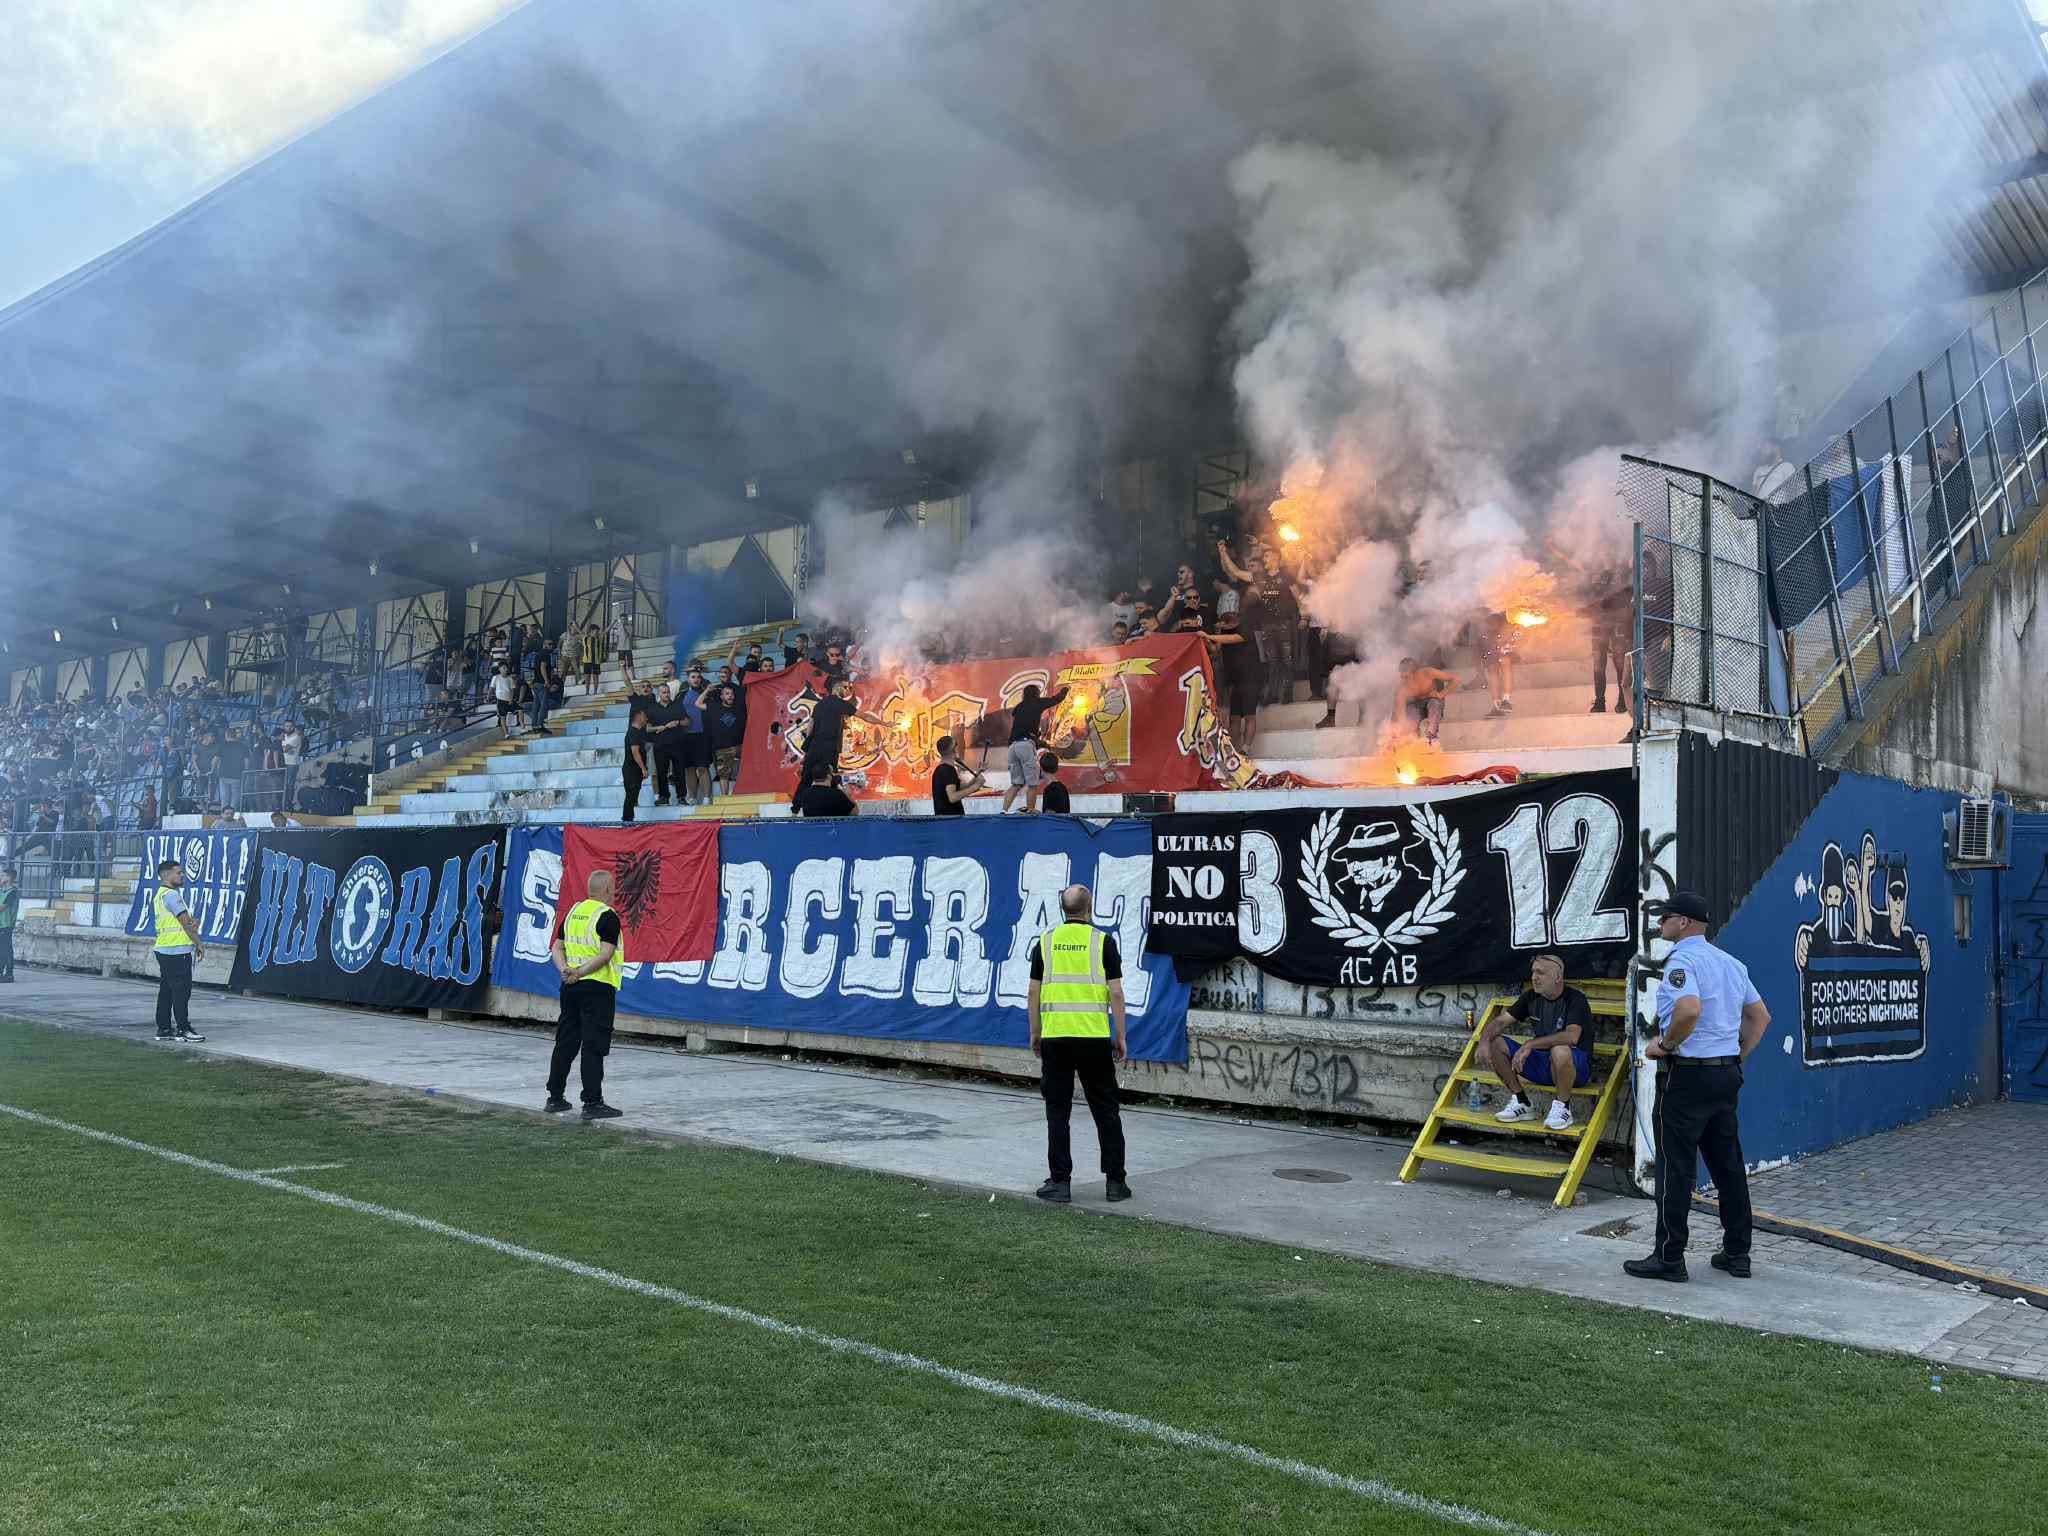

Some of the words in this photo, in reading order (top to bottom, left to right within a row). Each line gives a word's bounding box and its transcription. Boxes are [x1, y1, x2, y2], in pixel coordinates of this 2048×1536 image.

[1157, 834, 1235, 852] ULTRAS
[1166, 864, 1226, 899] NO
[1487, 792, 1629, 949] 12
[1152, 909, 1236, 927] POLITICA
[1053, 943, 1087, 952] SECURITY
[1811, 981, 1834, 1004] FOR
[1835, 979, 1887, 1003] SOMEONE
[1889, 979, 1919, 1000] IDOLS
[1812, 1007, 1831, 1026] FOR
[1833, 1004, 1867, 1025] OTHERS
[1868, 1002, 1919, 1022] NIGHTMARE
